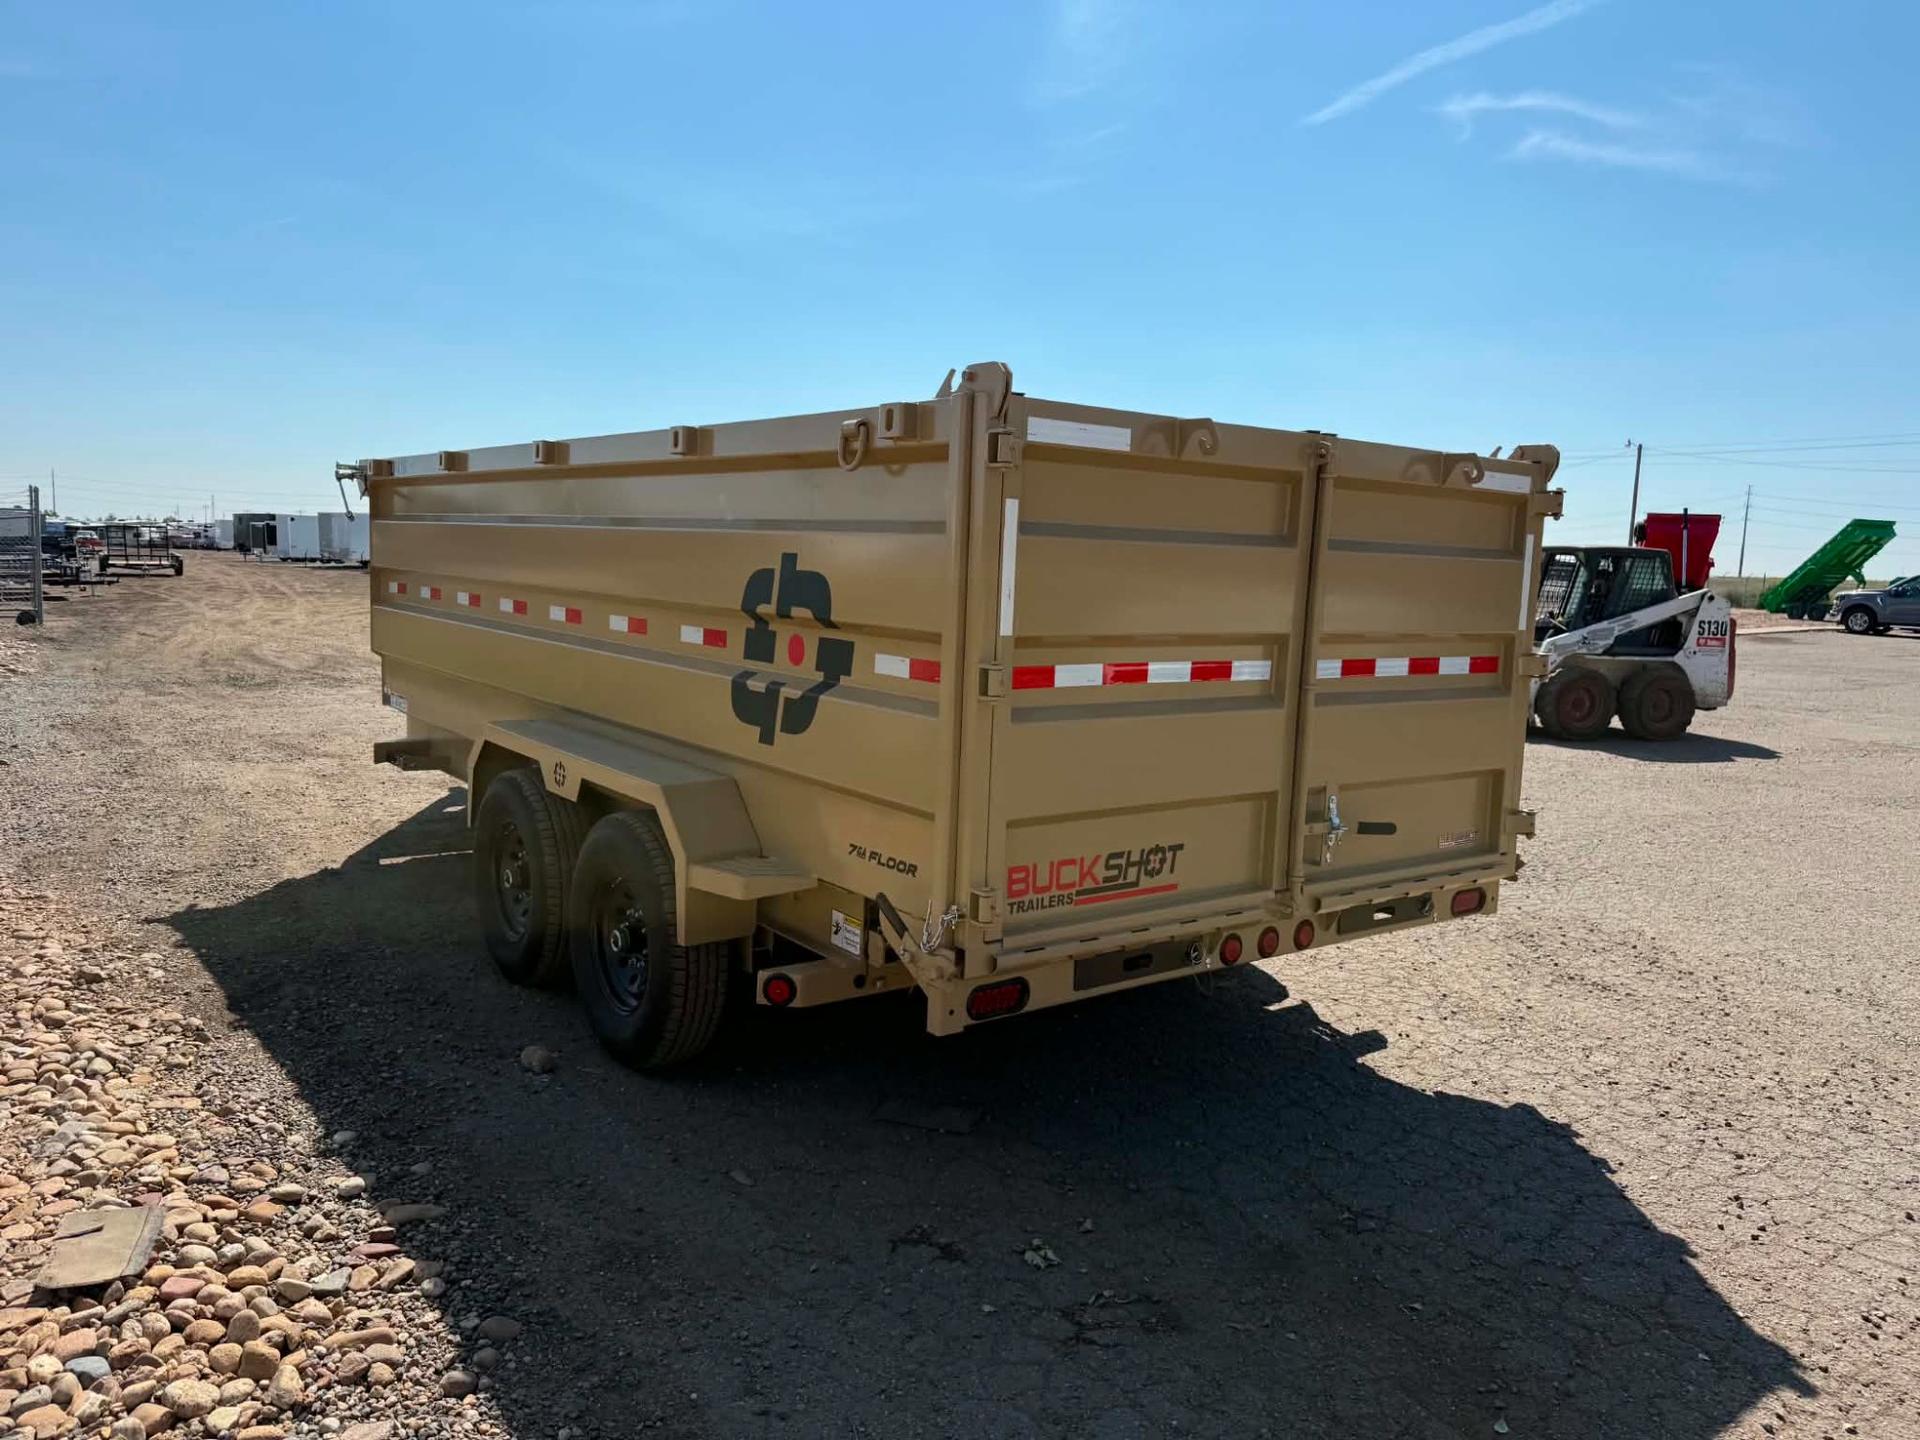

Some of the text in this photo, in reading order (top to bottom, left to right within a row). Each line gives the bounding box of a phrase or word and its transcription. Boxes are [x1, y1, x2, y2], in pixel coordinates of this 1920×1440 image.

[1698, 620, 1727, 636] S130
[868, 850, 918, 877] FLOOR
[1007, 843, 1184, 899] BUCKSHOT
[1008, 893, 1074, 915] TRAILERS
